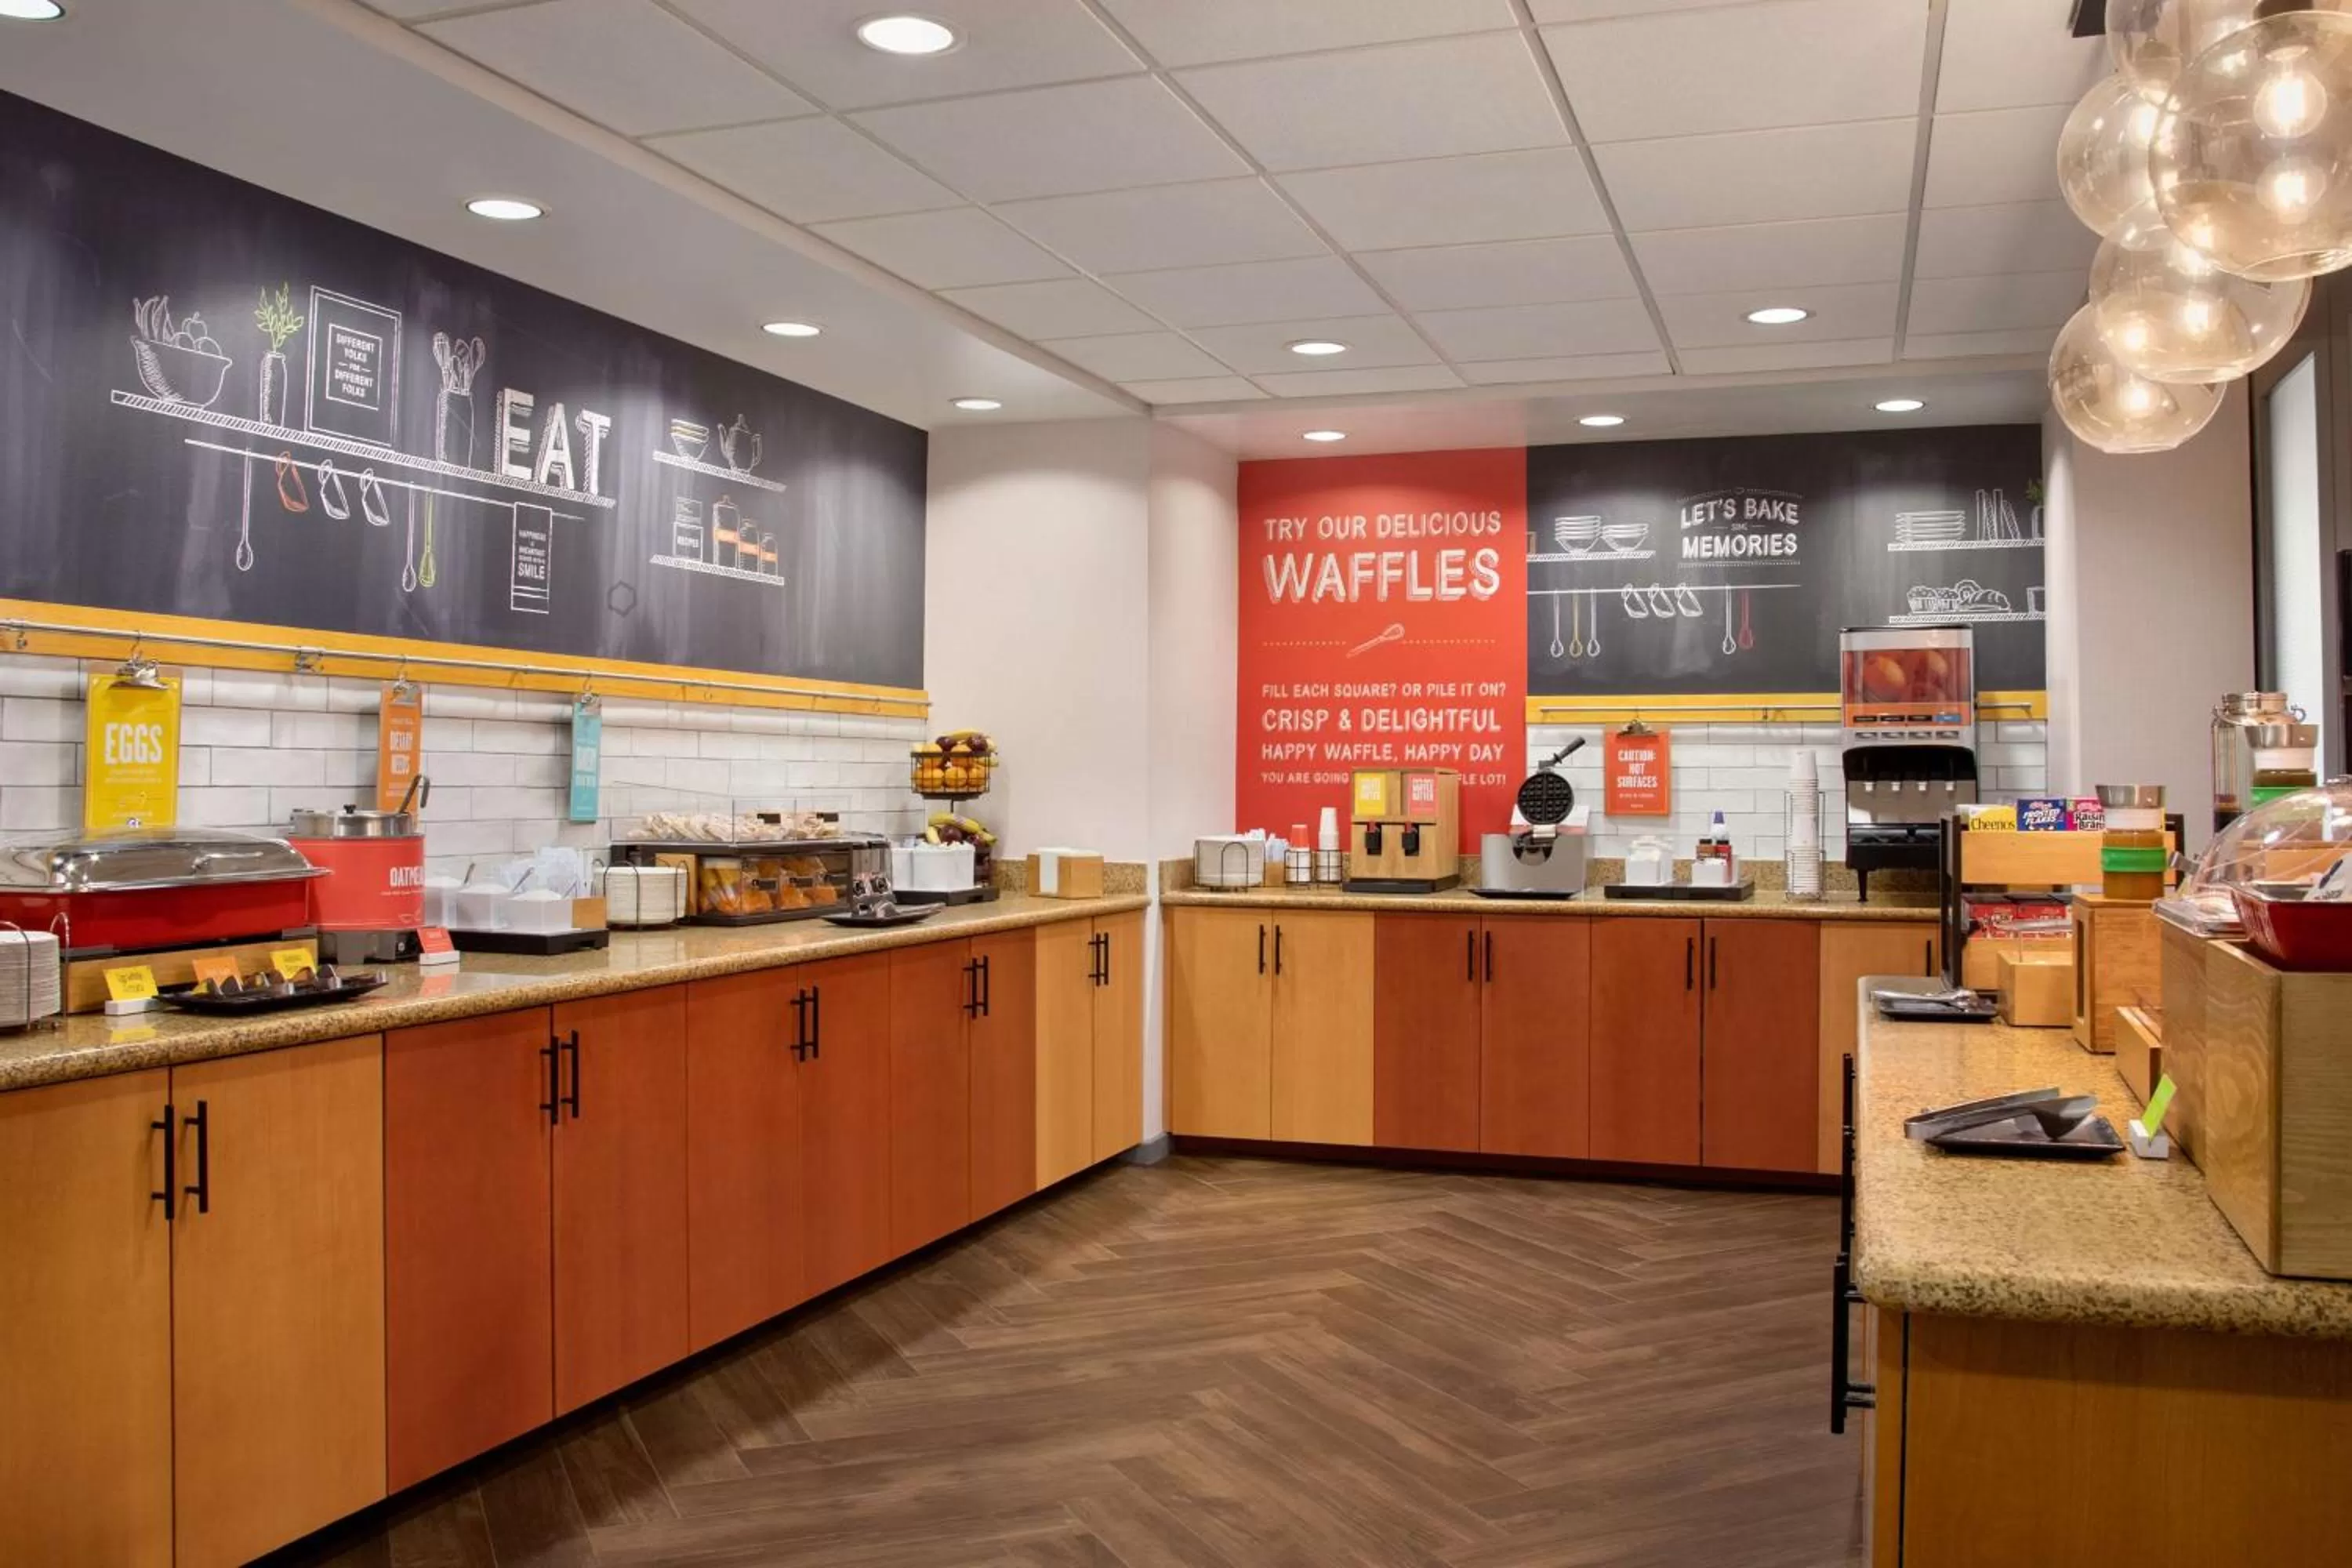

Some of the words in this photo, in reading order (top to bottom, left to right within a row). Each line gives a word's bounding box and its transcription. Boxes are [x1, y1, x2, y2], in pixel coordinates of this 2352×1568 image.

[336, 332, 375, 354] DIFFERENT
[334, 368, 374, 388] DIFFERENT
[495, 388, 612, 495] EAT
[1680, 498, 1737, 530] LET'S
[1744, 498, 1800, 526] BAKE
[1265, 517, 1308, 540] TRY
[1318, 515, 1367, 539] OUR
[1377, 510, 1502, 538] DELICIOUS
[1682, 533, 1798, 559] MEMORIES
[517, 562, 546, 580] SMILE
[1263, 548, 1501, 604] WAFFLES
[1261, 684, 1289, 698] FILL
[1293, 684, 1330, 698] EACH
[1334, 683, 1397, 698] SQUARE?
[1402, 683, 1422, 697] OR
[1426, 683, 1457, 697] PILE
[1461, 683, 1475, 697] IT
[1479, 683, 1507, 697] ON?
[1261, 708, 1330, 732] CRISP
[1339, 709, 1353, 731] &
[1360, 708, 1502, 732] DELIGHTFUL
[104, 722, 163, 765] EGGS
[1261, 743, 1318, 761] HAPPY
[1325, 743, 1399, 763] WAFFLE,
[1404, 743, 1463, 762] HAPPY
[1469, 743, 1505, 762] DAY
[1261, 771, 1284, 785] YOU
[1287, 771, 1311, 785] ARE
[1314, 771, 1349, 785] GOING
[1479, 773, 1507, 786] LOT!
[1628, 763, 1645, 775] HOT
[1617, 775, 1659, 789] SURFACES
[1970, 818, 2016, 831] Cheerios
[2075, 812, 2106, 822] Raisin
